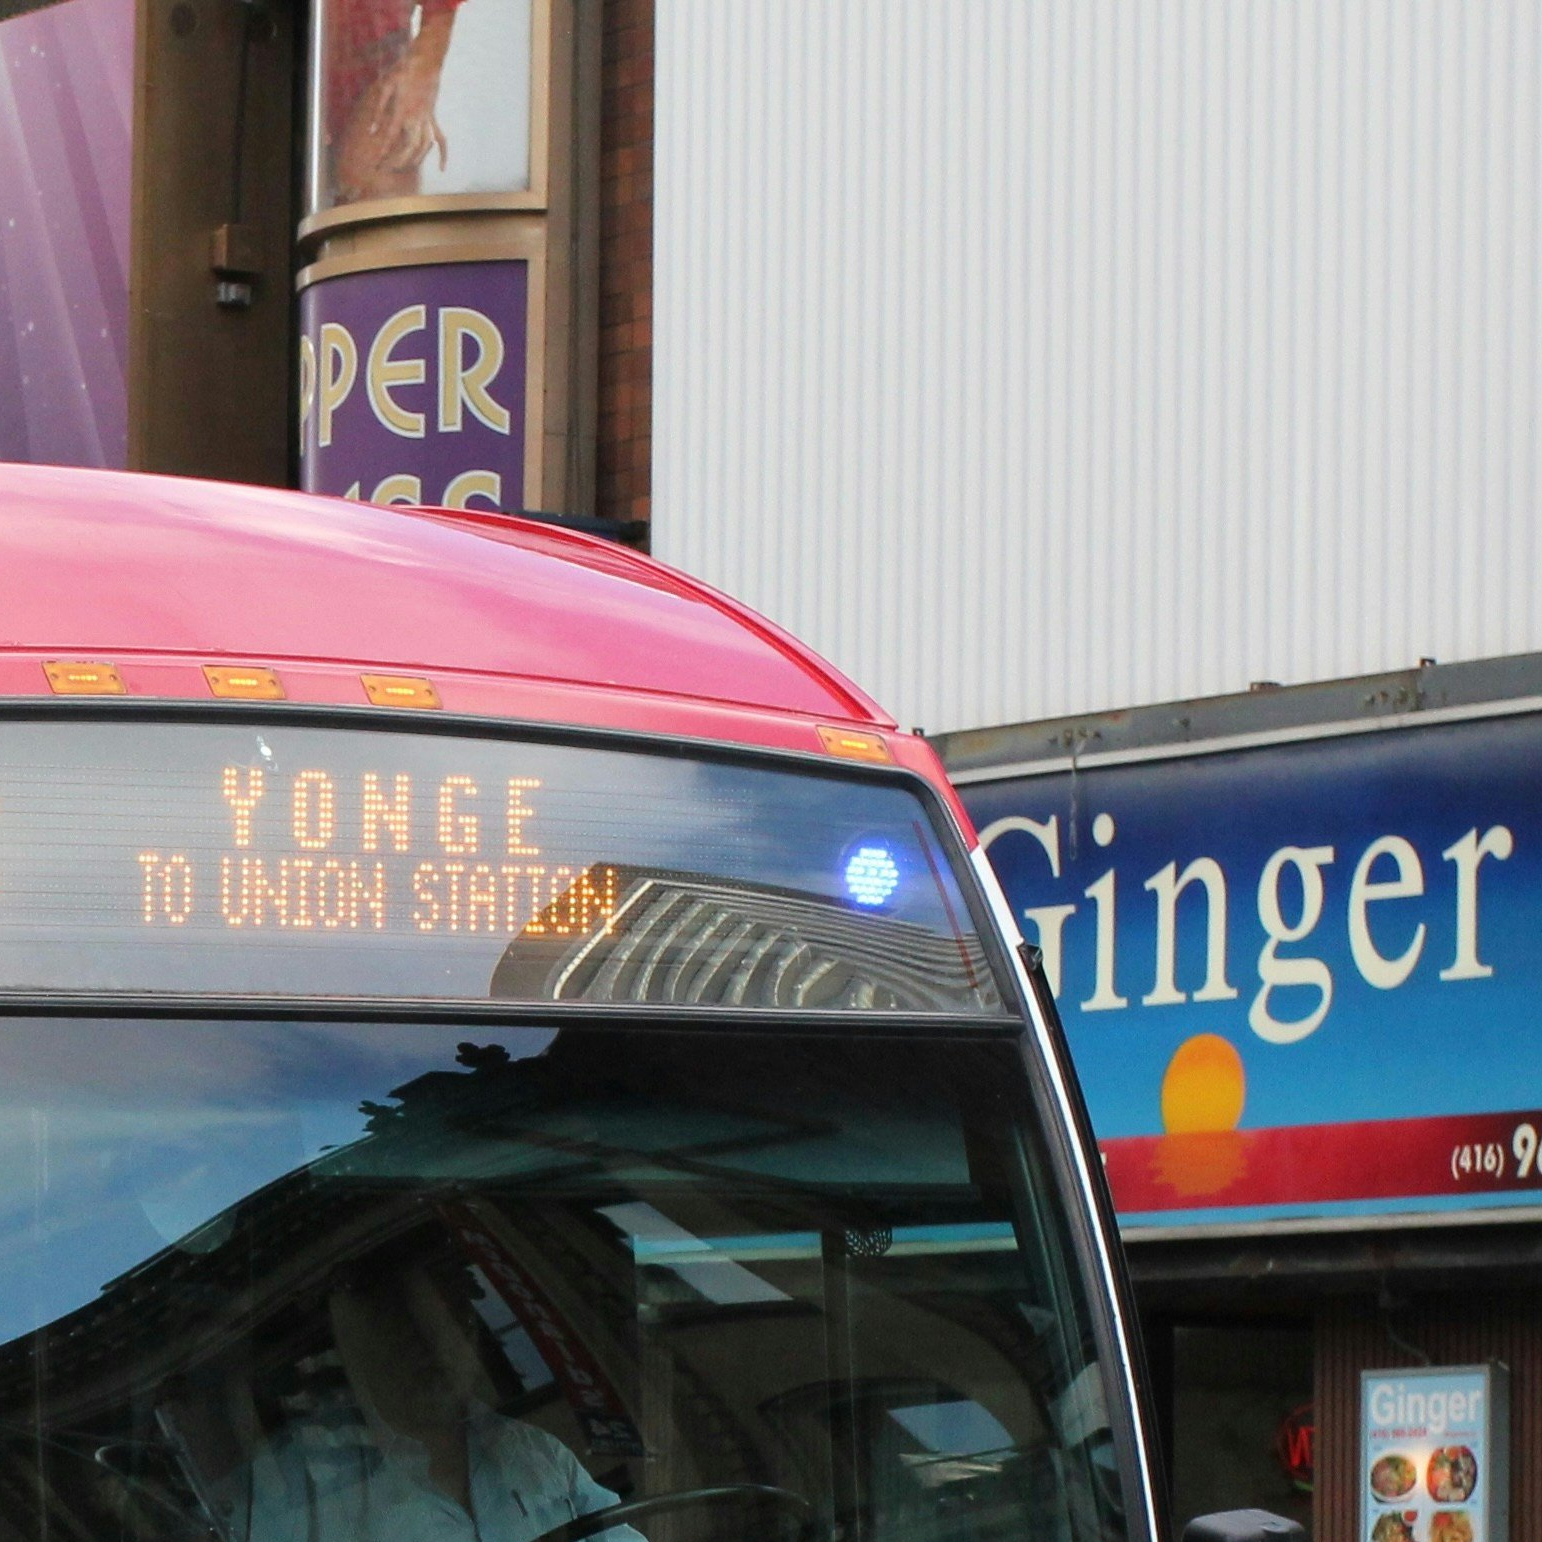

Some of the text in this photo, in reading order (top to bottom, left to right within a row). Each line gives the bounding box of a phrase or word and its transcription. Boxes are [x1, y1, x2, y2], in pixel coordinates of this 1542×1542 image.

[222, 766, 543, 857] YONGE
[137, 853, 618, 935] TO UNION STATION
[1451, 1122, 1542, 1181] (416) 9
[1372, 1383, 1484, 1433] Ginger
